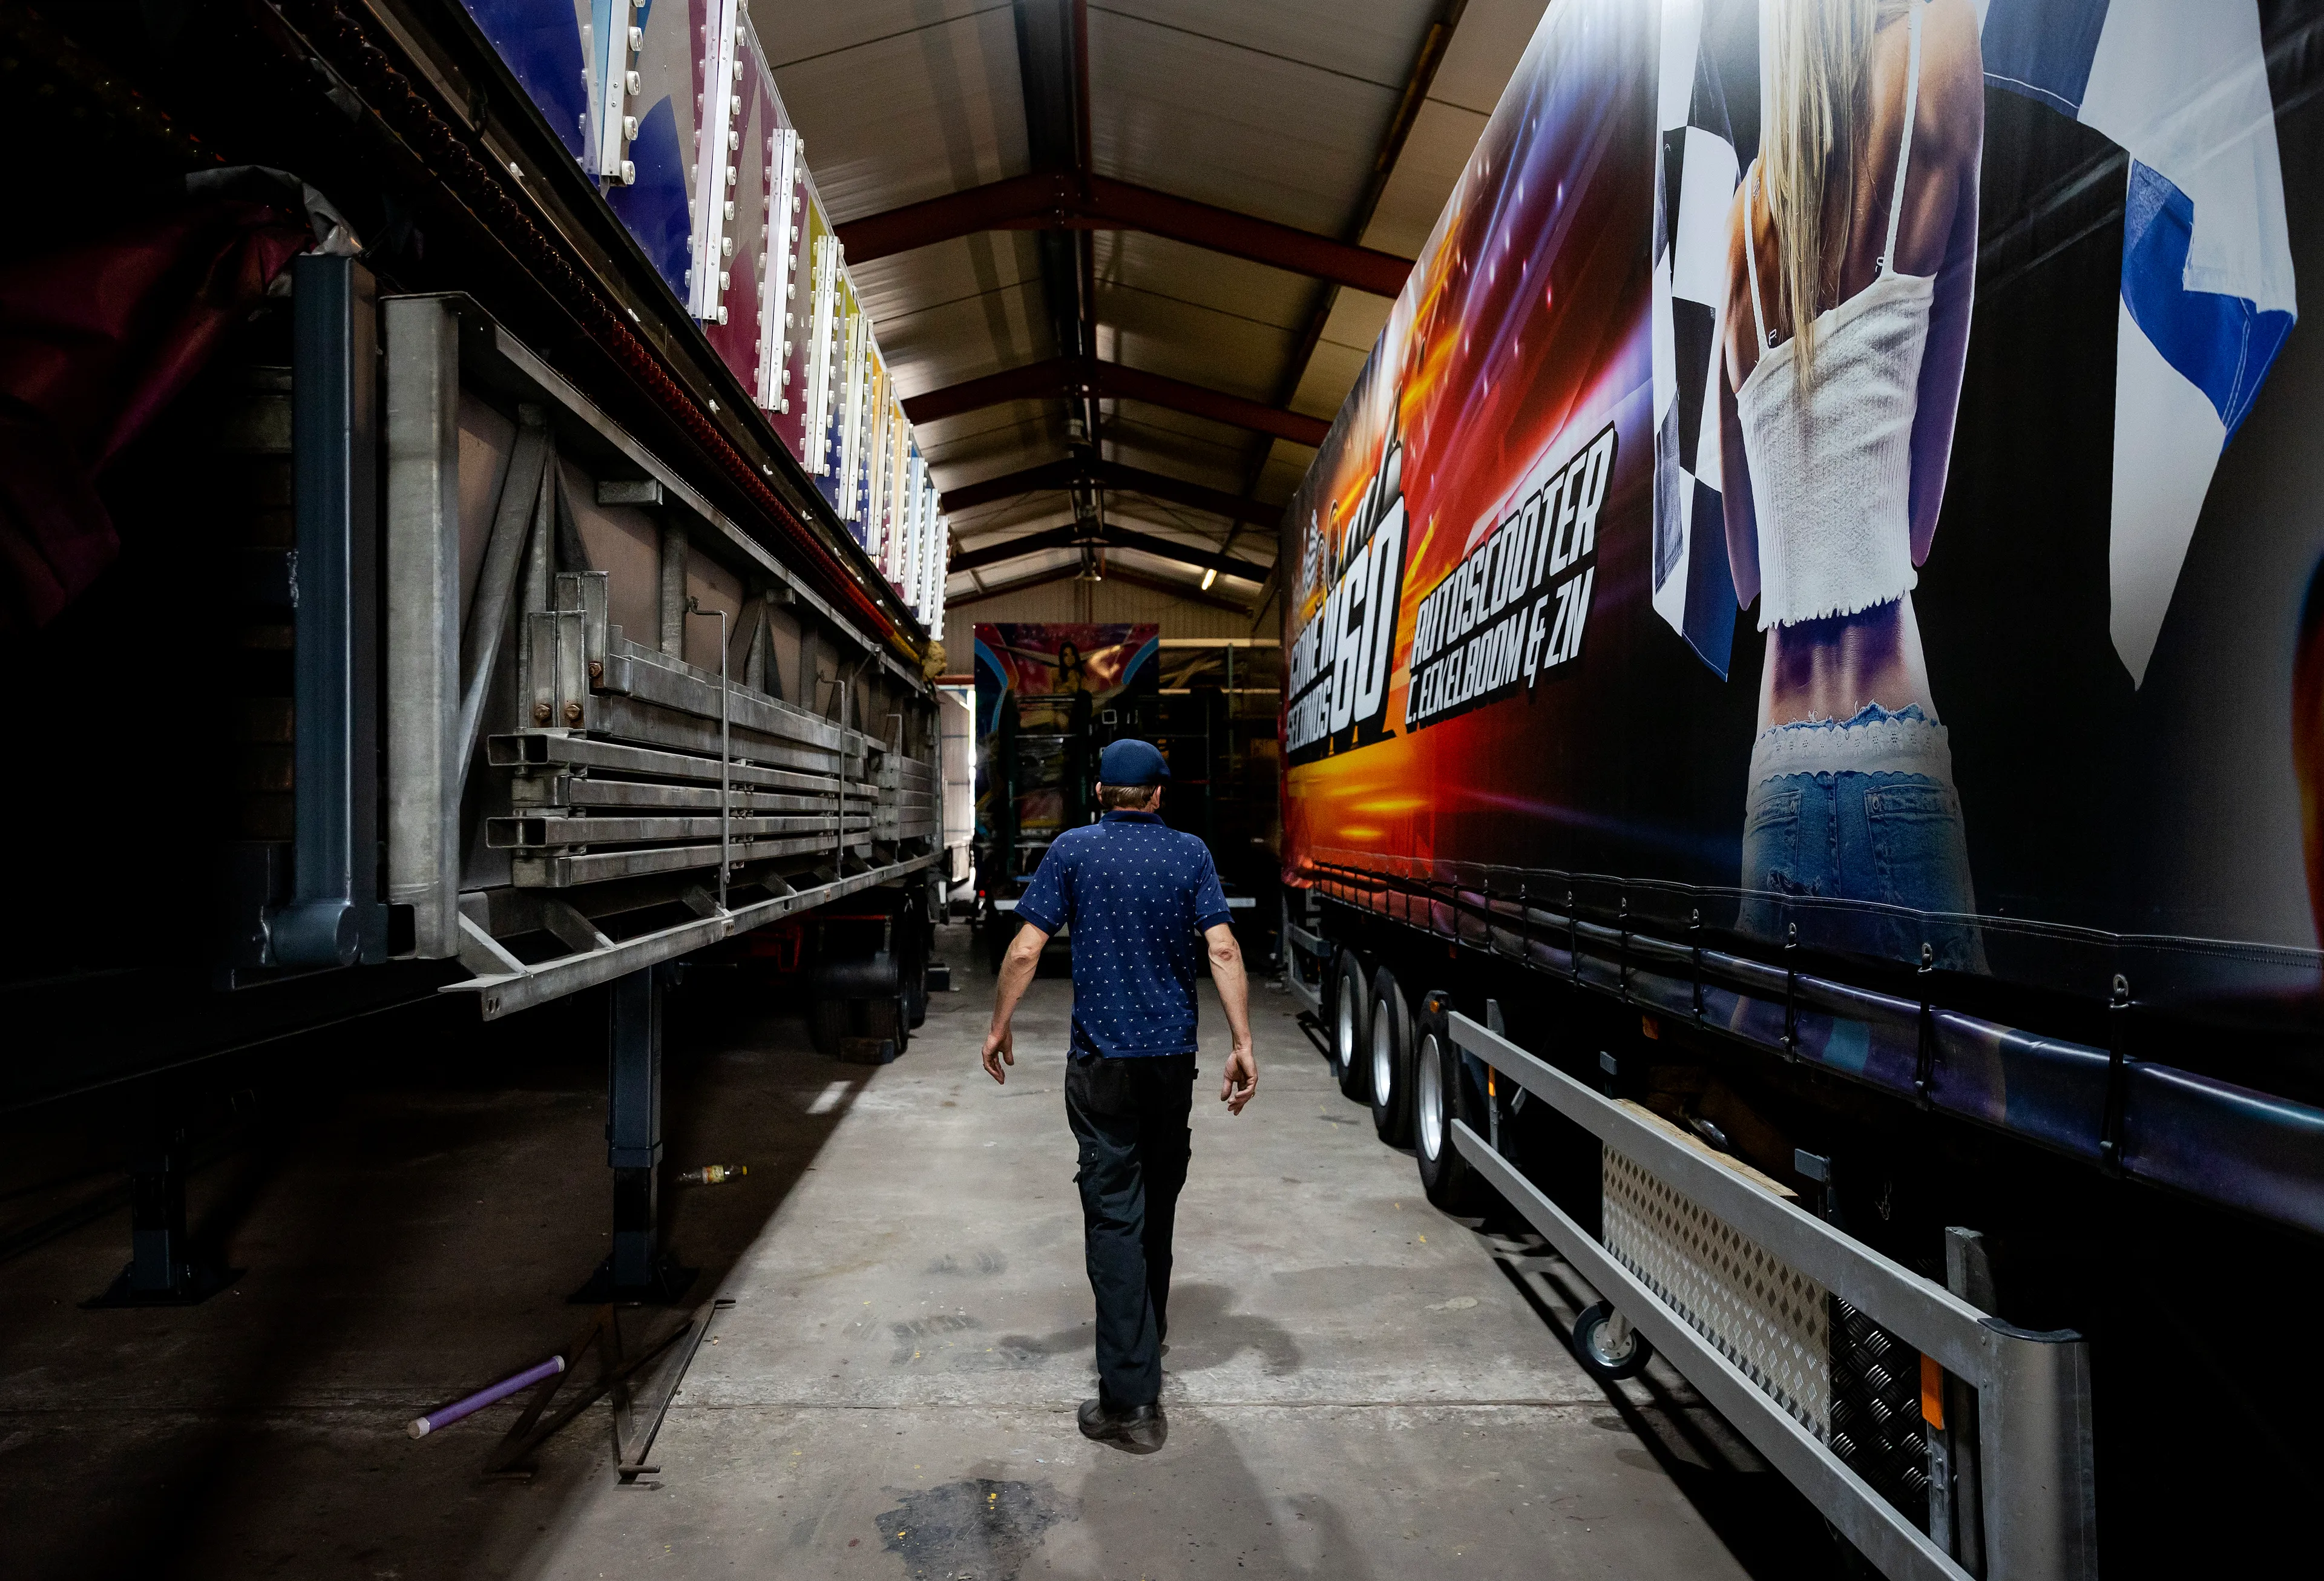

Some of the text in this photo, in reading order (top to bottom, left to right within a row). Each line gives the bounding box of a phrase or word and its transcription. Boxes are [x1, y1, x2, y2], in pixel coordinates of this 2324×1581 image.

[1288, 496, 1405, 734] GONE IN 60
[1410, 427, 1615, 668] AUTOSCOOTER
[1524, 594, 1549, 688] &
[1544, 567, 1595, 668] ZN
[1285, 675, 1333, 754] SECONDS
